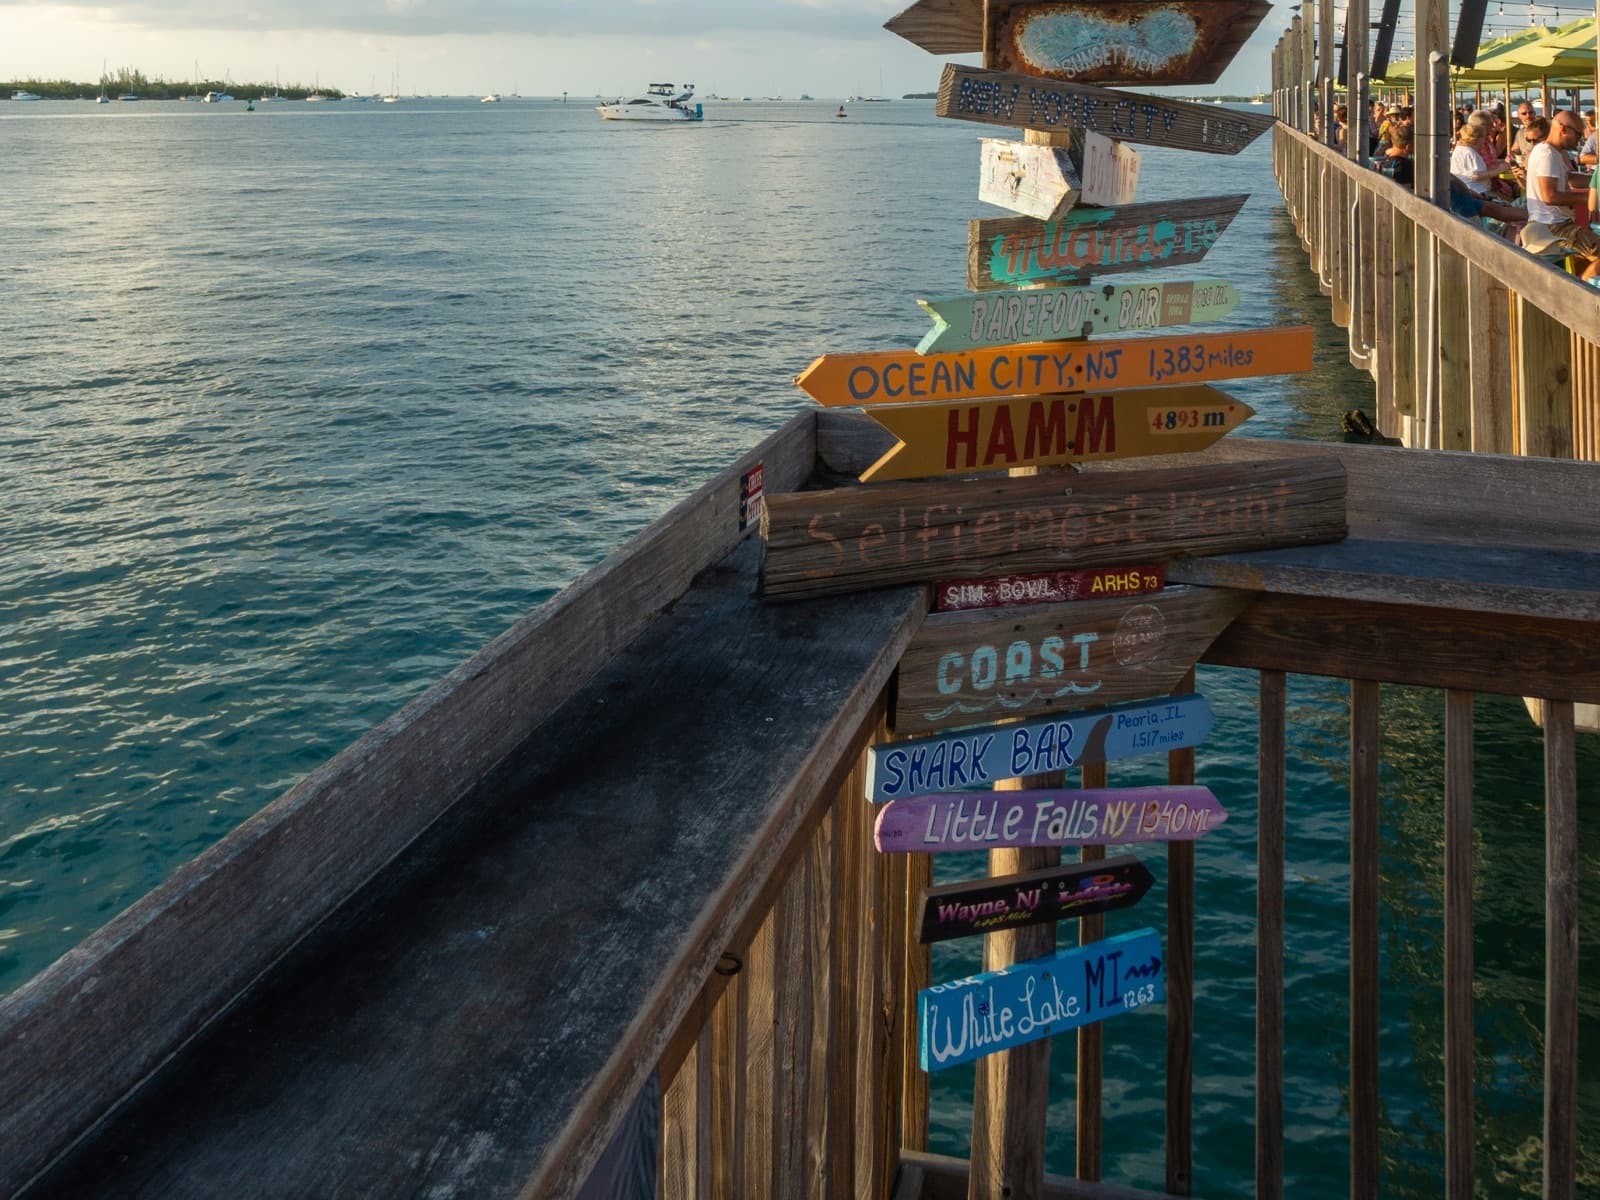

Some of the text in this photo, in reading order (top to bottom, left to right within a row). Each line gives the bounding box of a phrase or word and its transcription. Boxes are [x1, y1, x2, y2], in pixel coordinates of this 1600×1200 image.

[1061, 43, 1158, 79] SUNSET PIER
[958, 77, 1020, 119] NEW
[1029, 87, 1099, 130] YORK
[1111, 97, 1178, 139] CITY
[969, 289, 1097, 342] BAREFOOT
[1118, 287, 1161, 330] BAR
[847, 344, 1255, 400] OCEAN CITY, NJ 1,383 miles
[945, 396, 1117, 470] HAMM
[1150, 407, 1200, 431] 4893
[1091, 571, 1140, 593] ARHS
[1143, 575, 1158, 589] 73
[936, 631, 1099, 695] COAST
[1159, 729, 1185, 744] miles
[1163, 705, 1185, 721] IL
[881, 721, 1076, 796] SHARK BAR
[1101, 800, 1137, 840] NY
[1136, 800, 1189, 835] 1340
[1188, 807, 1213, 833] MI
[937, 898, 1010, 925] Wayne,
[1015, 888, 1042, 910] NJ
[929, 984, 1015, 1063] White
[1017, 975, 1081, 1035] Lake
[1085, 950, 1126, 1015] MI
[1123, 983, 1156, 1009] 1263
